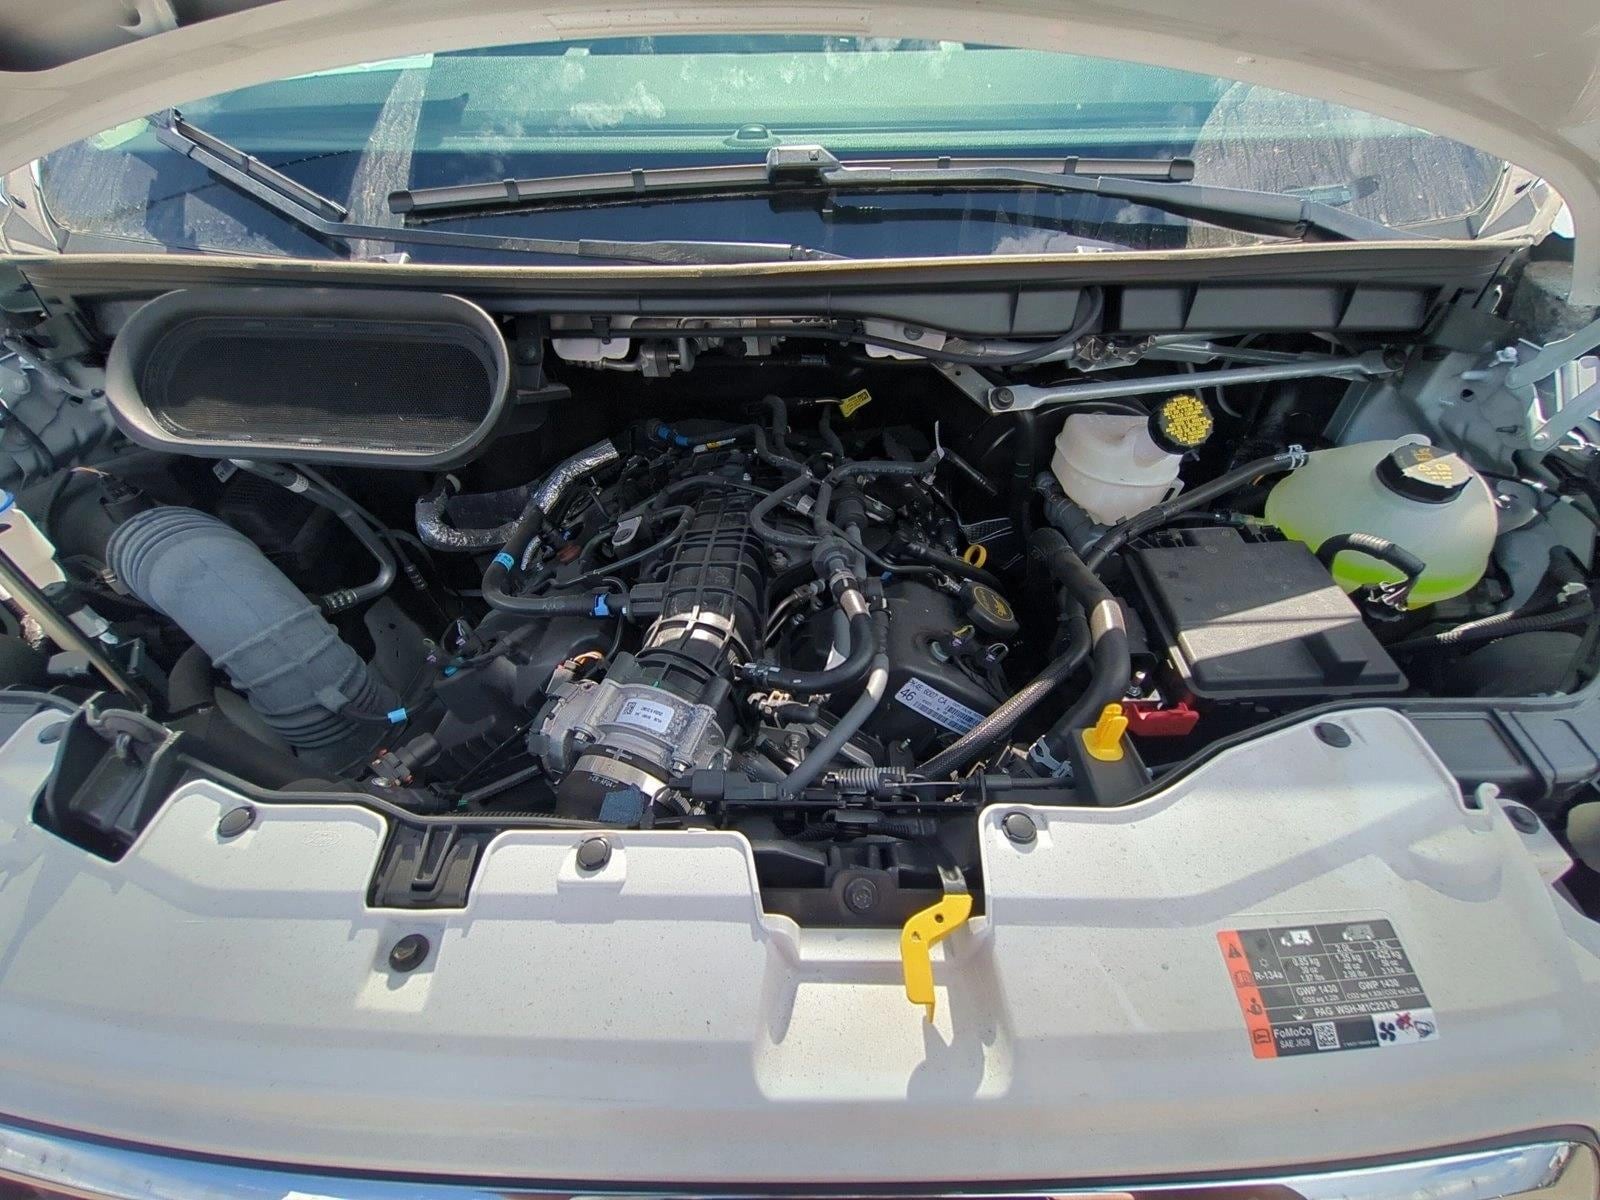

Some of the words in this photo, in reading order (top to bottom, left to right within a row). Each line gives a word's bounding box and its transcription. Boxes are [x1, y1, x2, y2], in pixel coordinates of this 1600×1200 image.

[900, 688, 916, 702] 46
[937, 696, 947, 705] CA
[1310, 957, 1320, 967] kg
[1352, 953, 1363, 963] kg
[1254, 970, 1284, 980] R-134a
[1295, 986, 1317, 996] GWP
[1318, 984, 1339, 994] 1430
[1358, 981, 1379, 990] GWP
[1379, 979, 1399, 988] 1430
[1314, 1007, 1334, 1017] PAG
[1335, 1000, 1399, 1015] WSH-M1C231-B
[1273, 1026, 1313, 1038] FoMoCo
